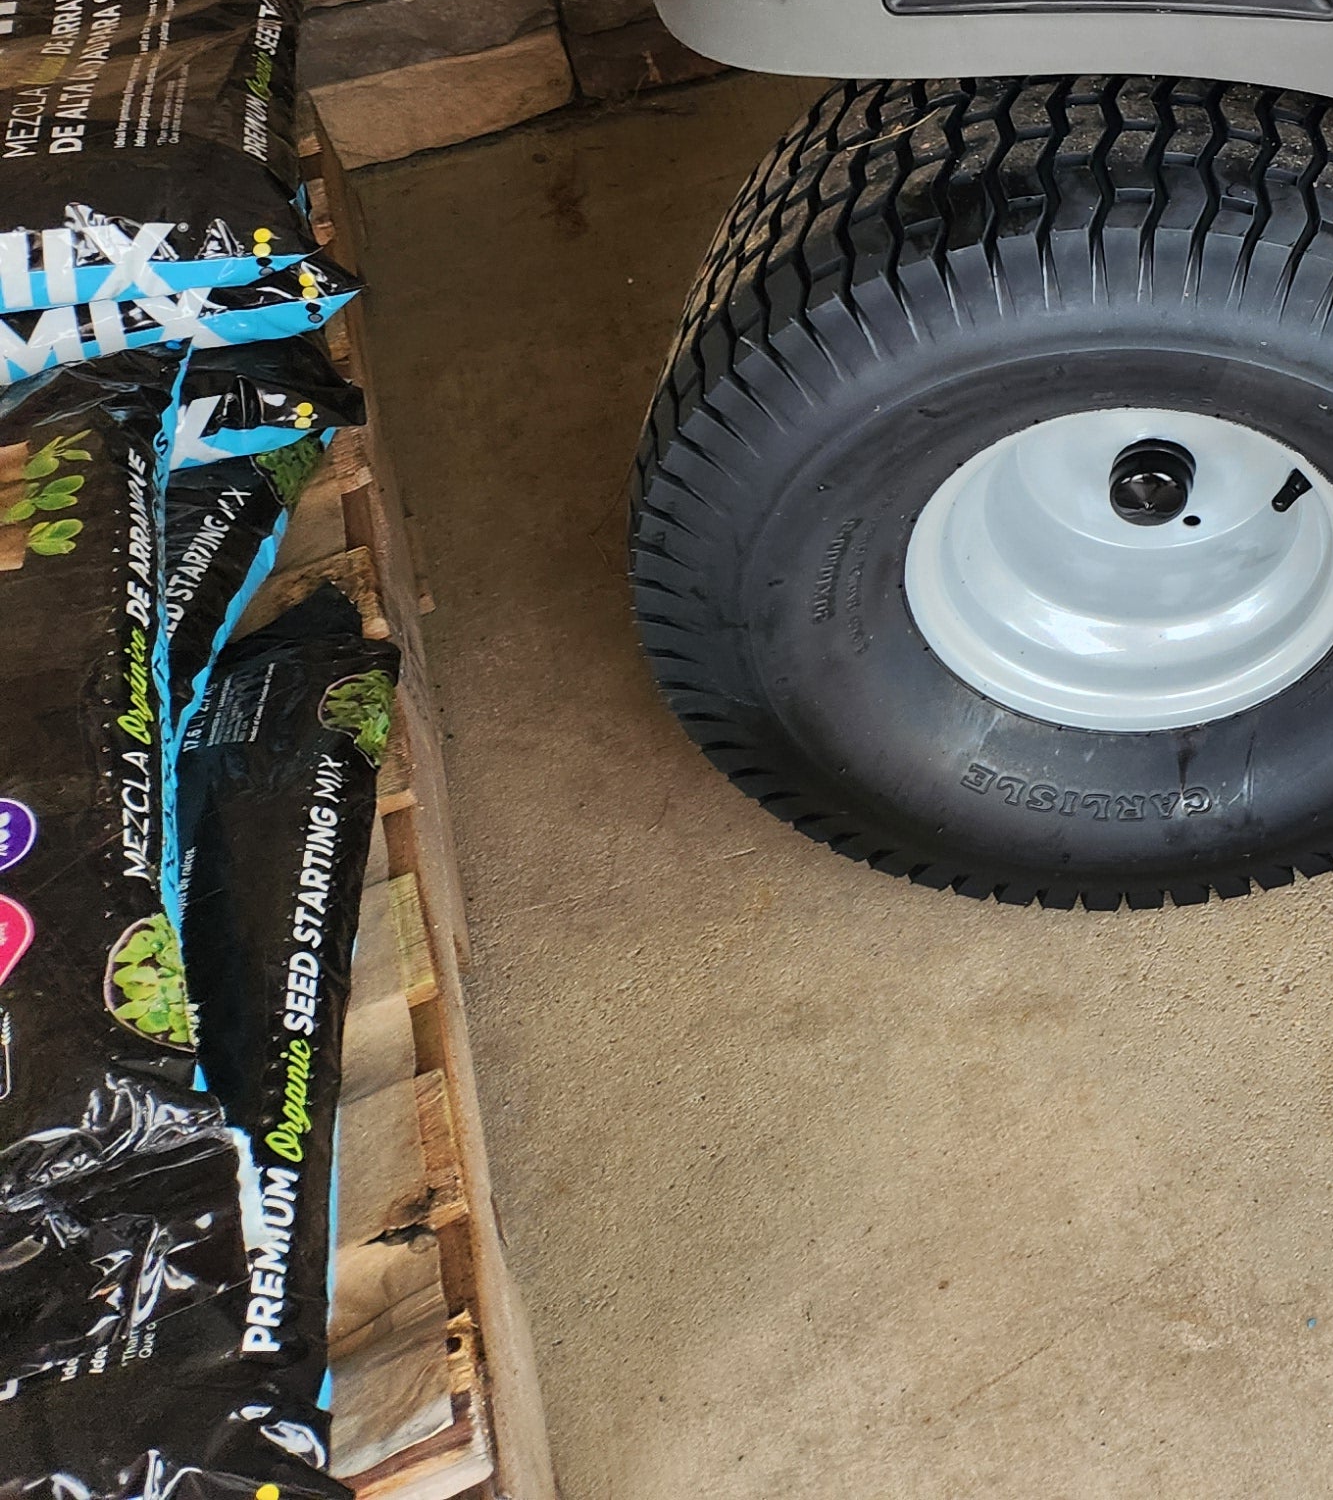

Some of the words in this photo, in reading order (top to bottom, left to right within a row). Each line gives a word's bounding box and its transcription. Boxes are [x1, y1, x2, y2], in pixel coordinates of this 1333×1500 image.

[2, 86, 49, 160] MEZCLA
[55, 83, 96, 119] ALTA
[49, 123, 86, 154] DE
[165, 515, 230, 601] STARTING
[126, 580, 151, 628] DE
[117, 626, 155, 745] Orgánica
[183, 729, 202, 753] 17.6
[314, 752, 348, 803] MIX
[122, 750, 152, 882] MEZCLA
[961, 761, 1211, 827] CARLISLE
[293, 806, 341, 949] STARTING
[285, 951, 324, 1036] SEED
[265, 1038, 313, 1163] Organic
[243, 1166, 300, 1354] PREMIUM
[139, 1332, 155, 1358] Que
